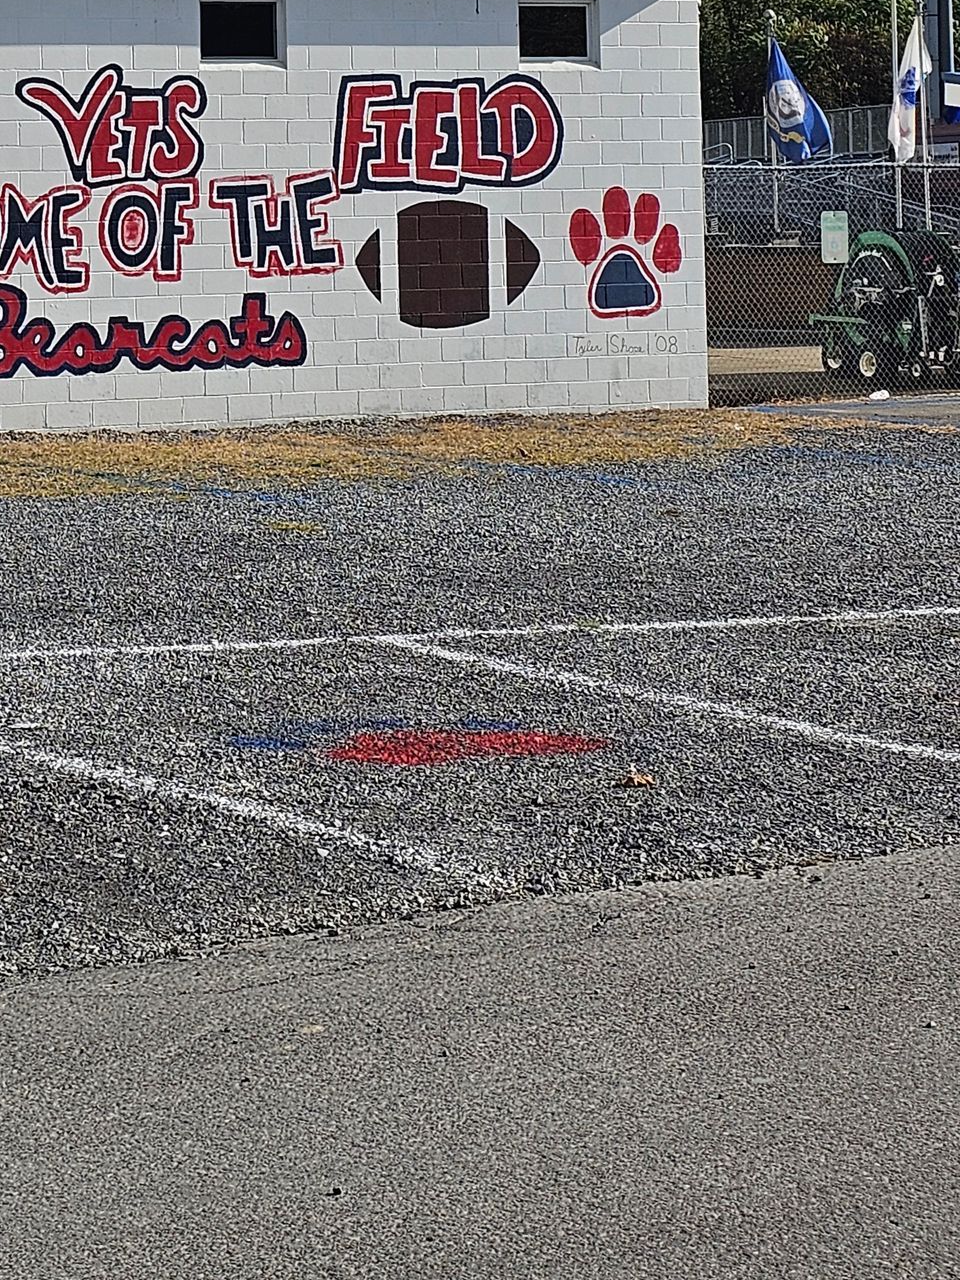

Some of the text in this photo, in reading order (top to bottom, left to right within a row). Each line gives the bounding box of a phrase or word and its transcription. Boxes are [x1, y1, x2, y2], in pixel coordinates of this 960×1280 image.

[16, 63, 207, 186] VETS
[334, 74, 563, 192] FIELD
[100, 178, 199, 282] OF
[210, 171, 344, 276] THE
[572, 335, 603, 357] Tyler
